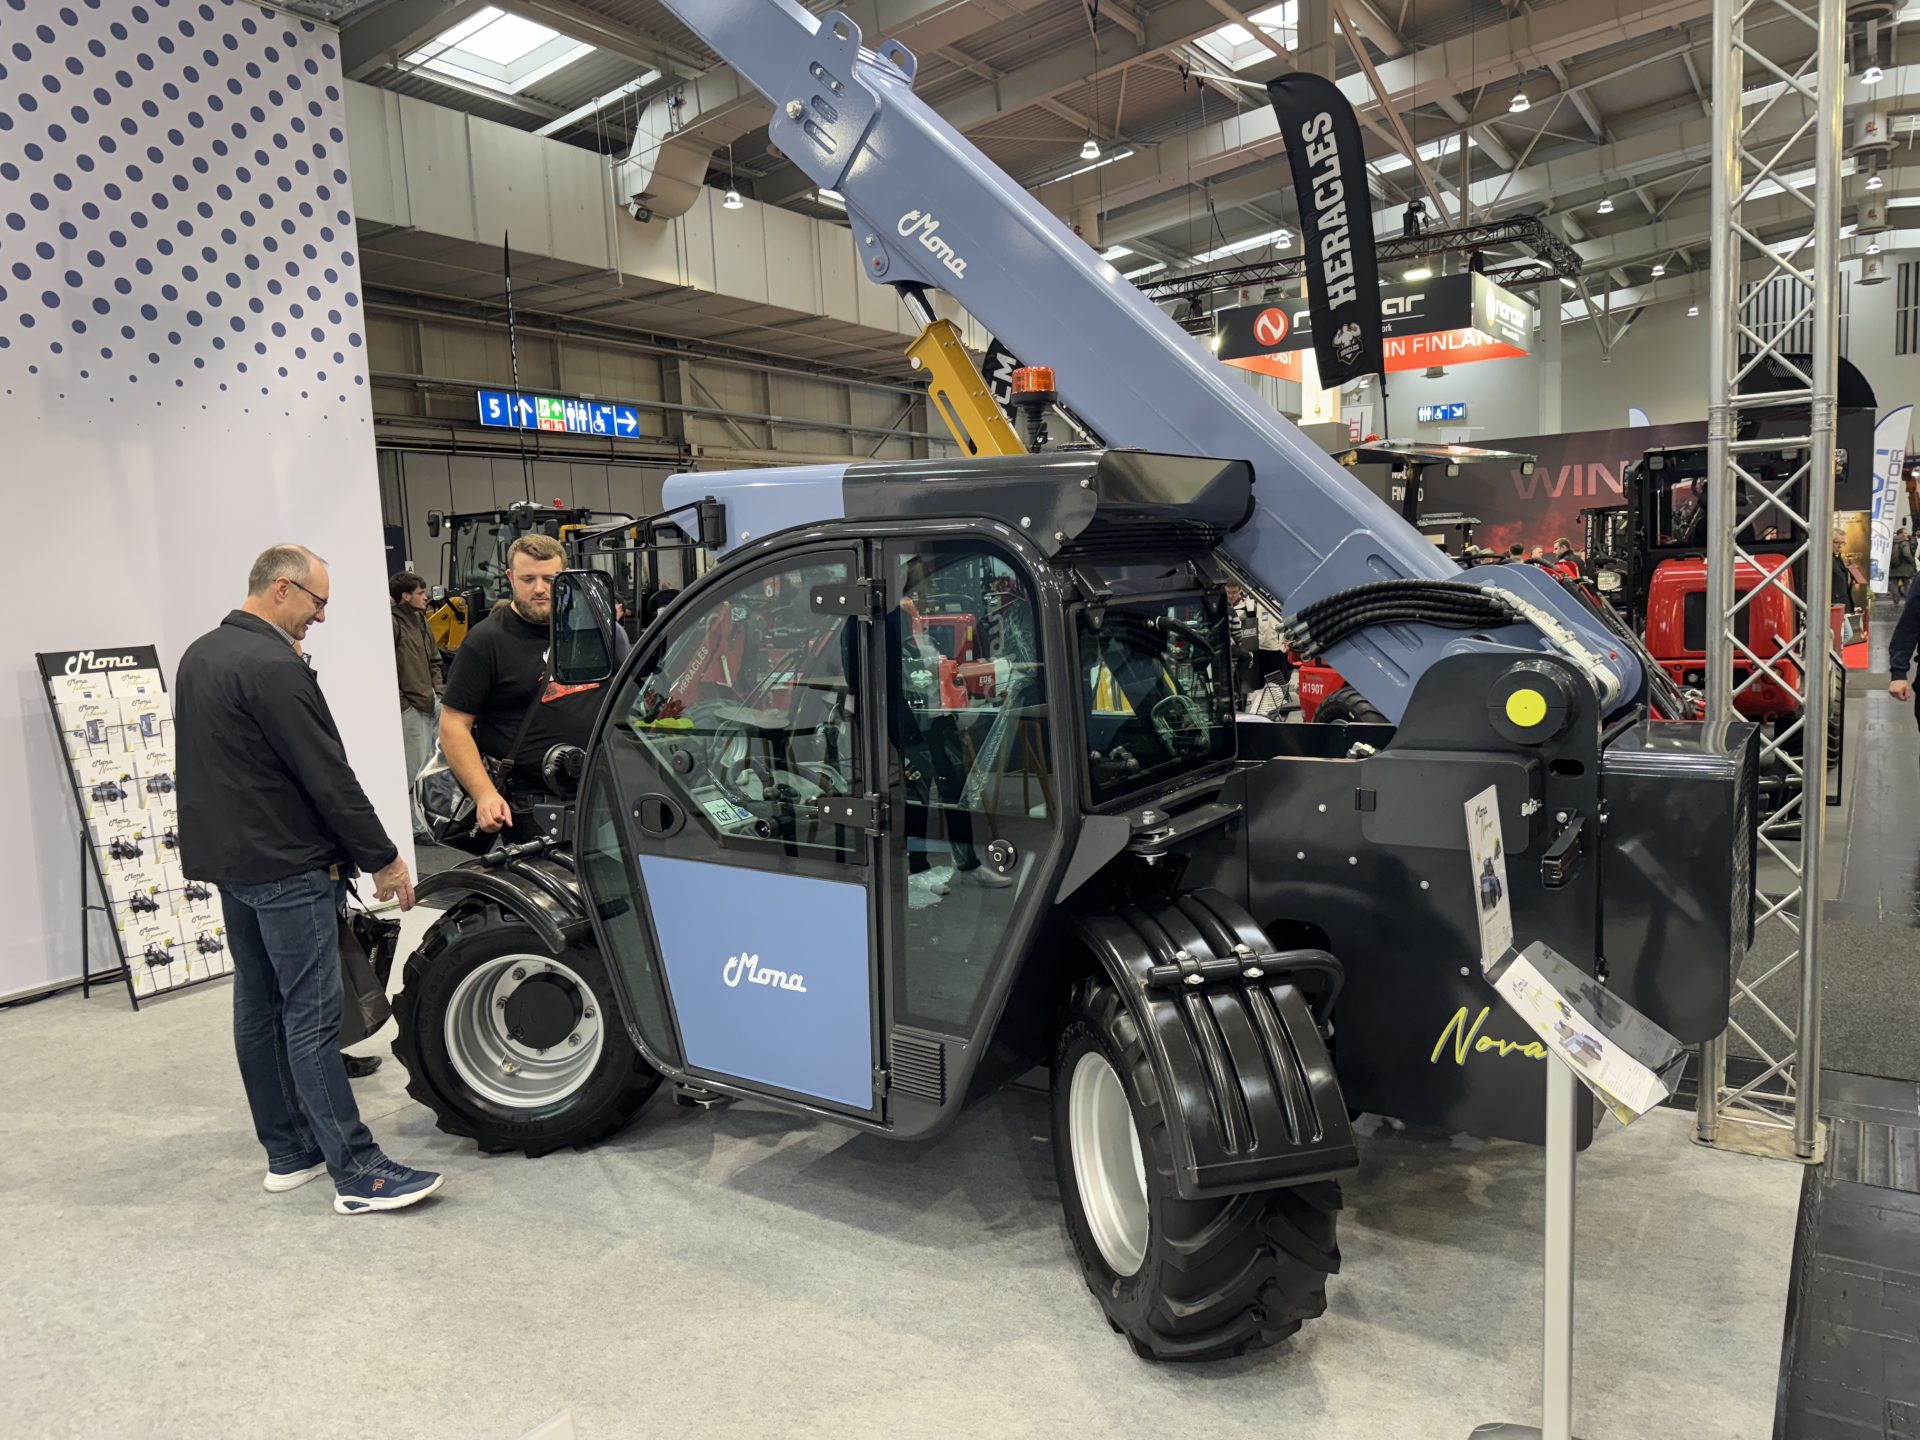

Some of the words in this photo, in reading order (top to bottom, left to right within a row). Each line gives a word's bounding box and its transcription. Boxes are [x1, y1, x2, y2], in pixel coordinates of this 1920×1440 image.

[1301, 111, 1357, 311] HERACLES
[897, 210, 968, 279] Mona
[1412, 329, 1502, 354] FINLAN
[489, 398, 501, 418] 5
[601, 406, 612, 415] WC
[1882, 449, 1904, 520] MOTOR
[64, 651, 138, 676] Mona
[677, 646, 709, 695] HERACLES
[1302, 683, 1325, 695] H190T
[722, 951, 807, 993] Mona
[1430, 1006, 1547, 1065] Nova
